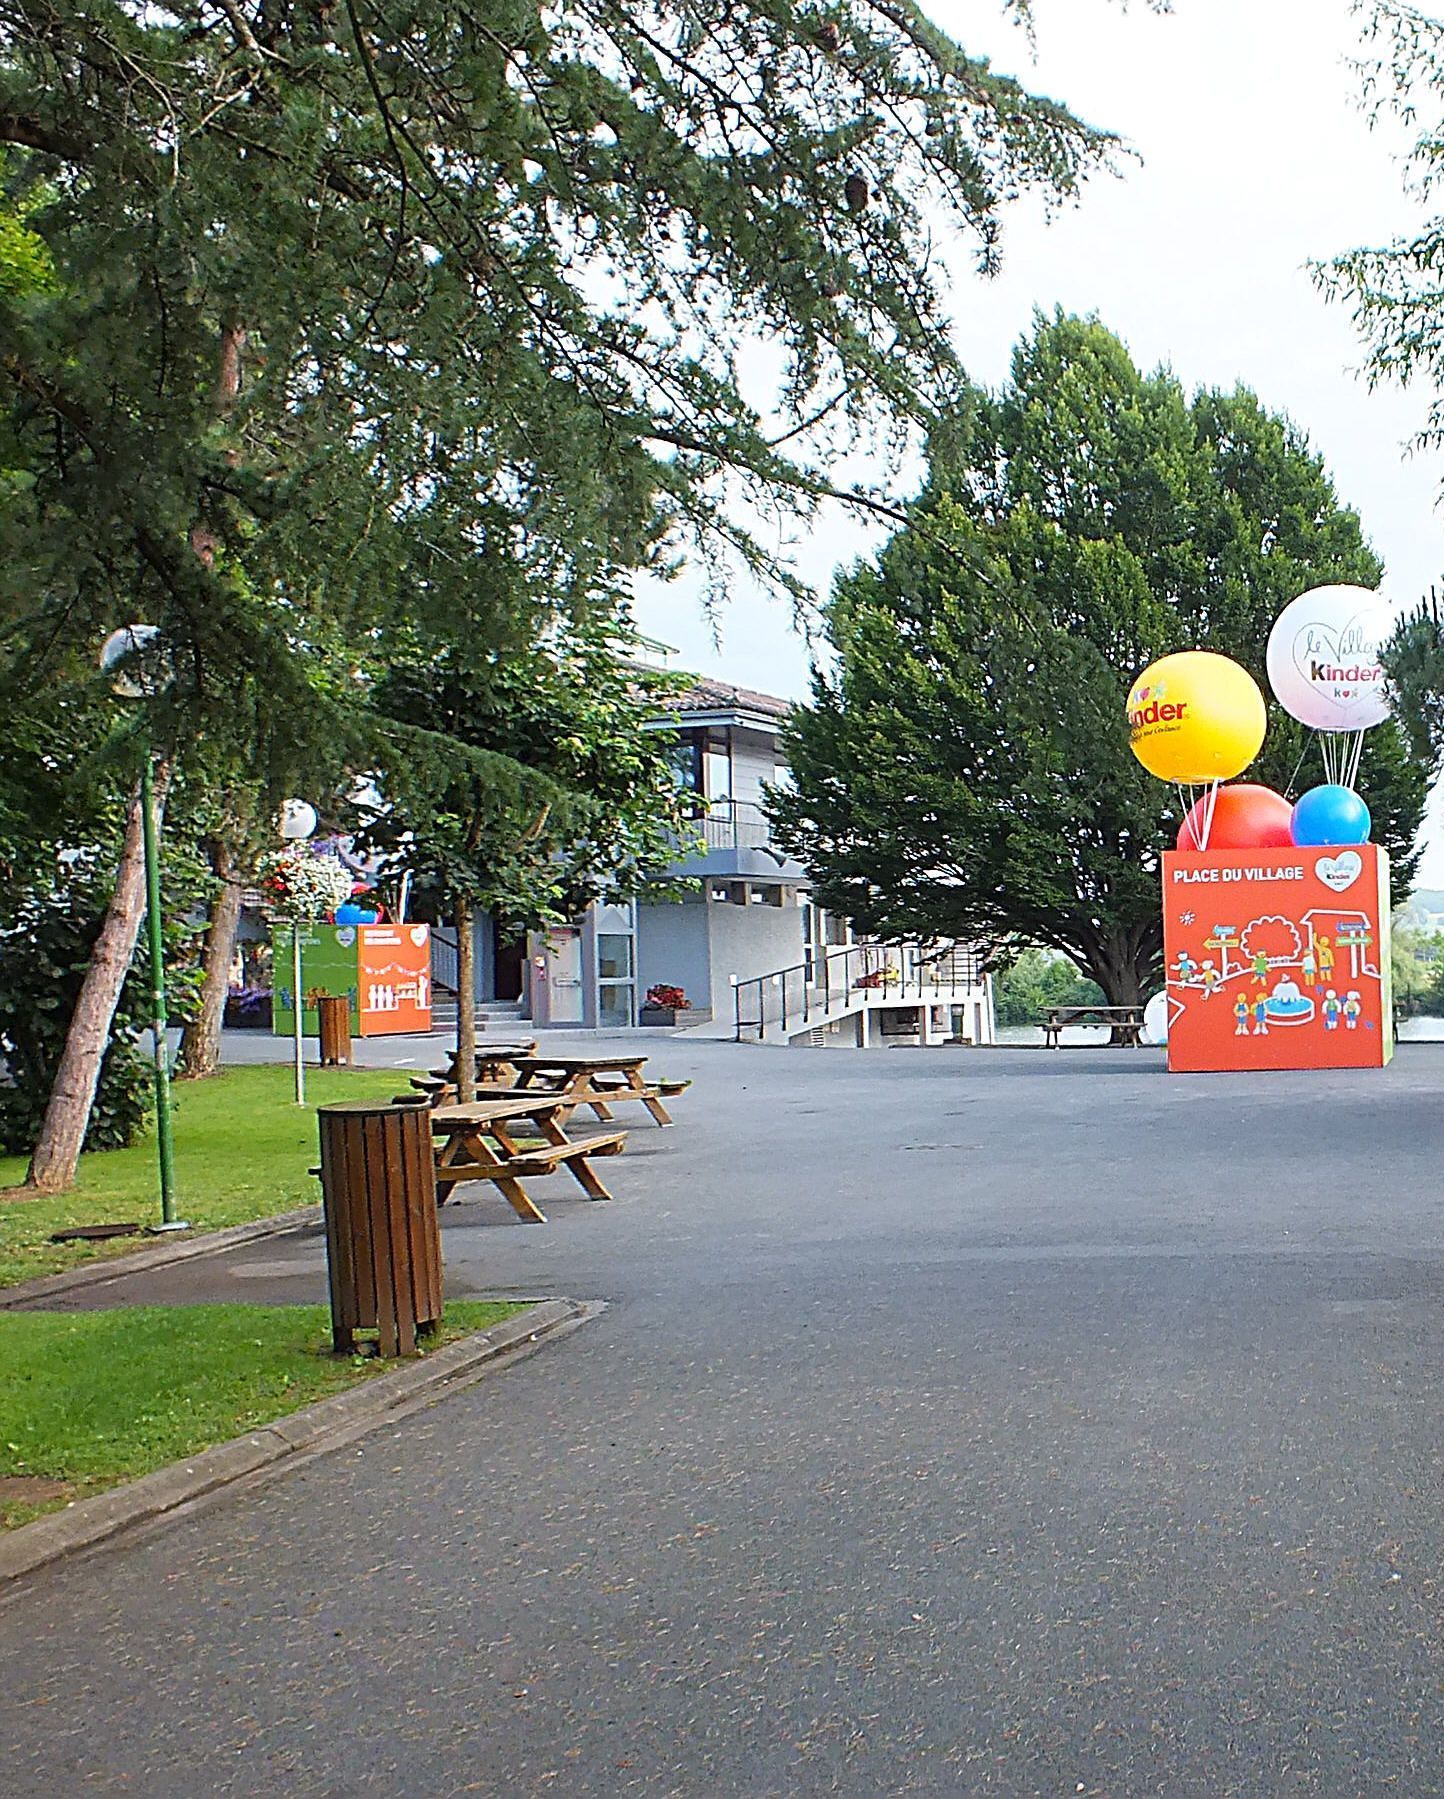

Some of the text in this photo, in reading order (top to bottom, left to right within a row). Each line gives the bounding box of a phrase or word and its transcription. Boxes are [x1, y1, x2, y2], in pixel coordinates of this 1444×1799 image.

[1311, 660, 1381, 681] Kinder
[1173, 868, 1219, 884] PLACE
[1222, 868, 1242, 883] DU
[1244, 866, 1304, 882] VILLAGE
